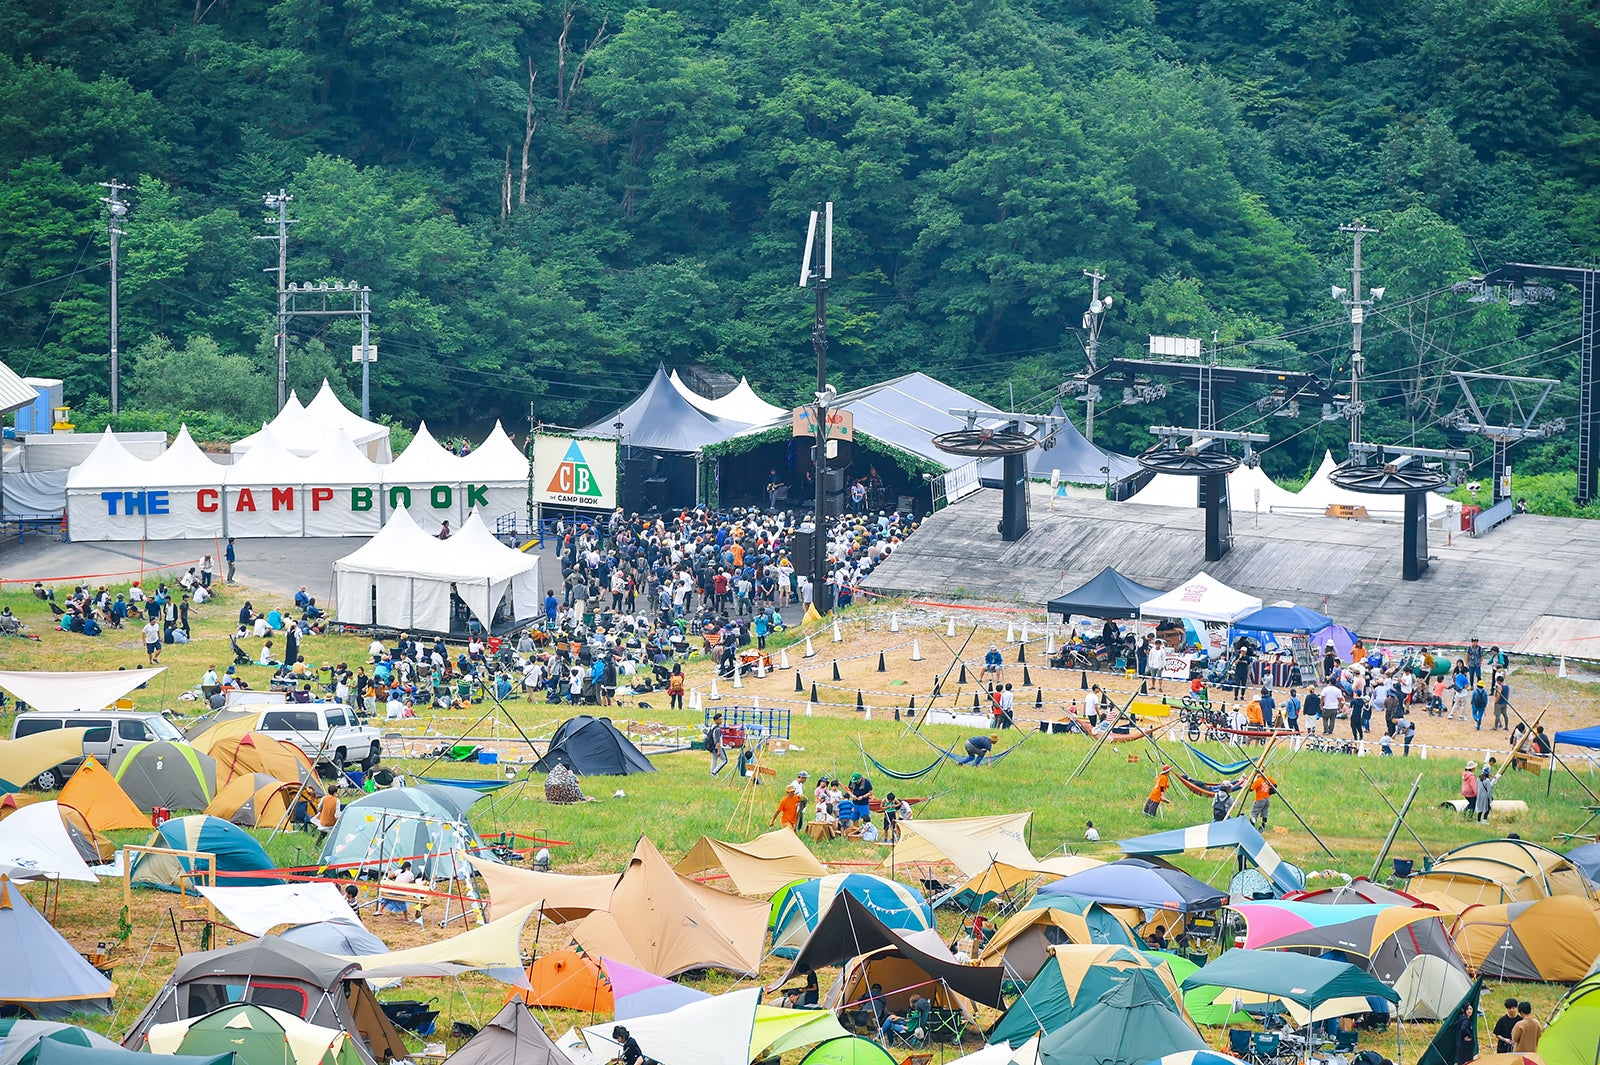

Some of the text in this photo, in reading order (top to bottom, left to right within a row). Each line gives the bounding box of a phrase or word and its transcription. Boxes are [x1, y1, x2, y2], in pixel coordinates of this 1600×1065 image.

[101, 484, 489, 516] THE CAMP BOOK
[579, 497, 598, 505] BOOK
